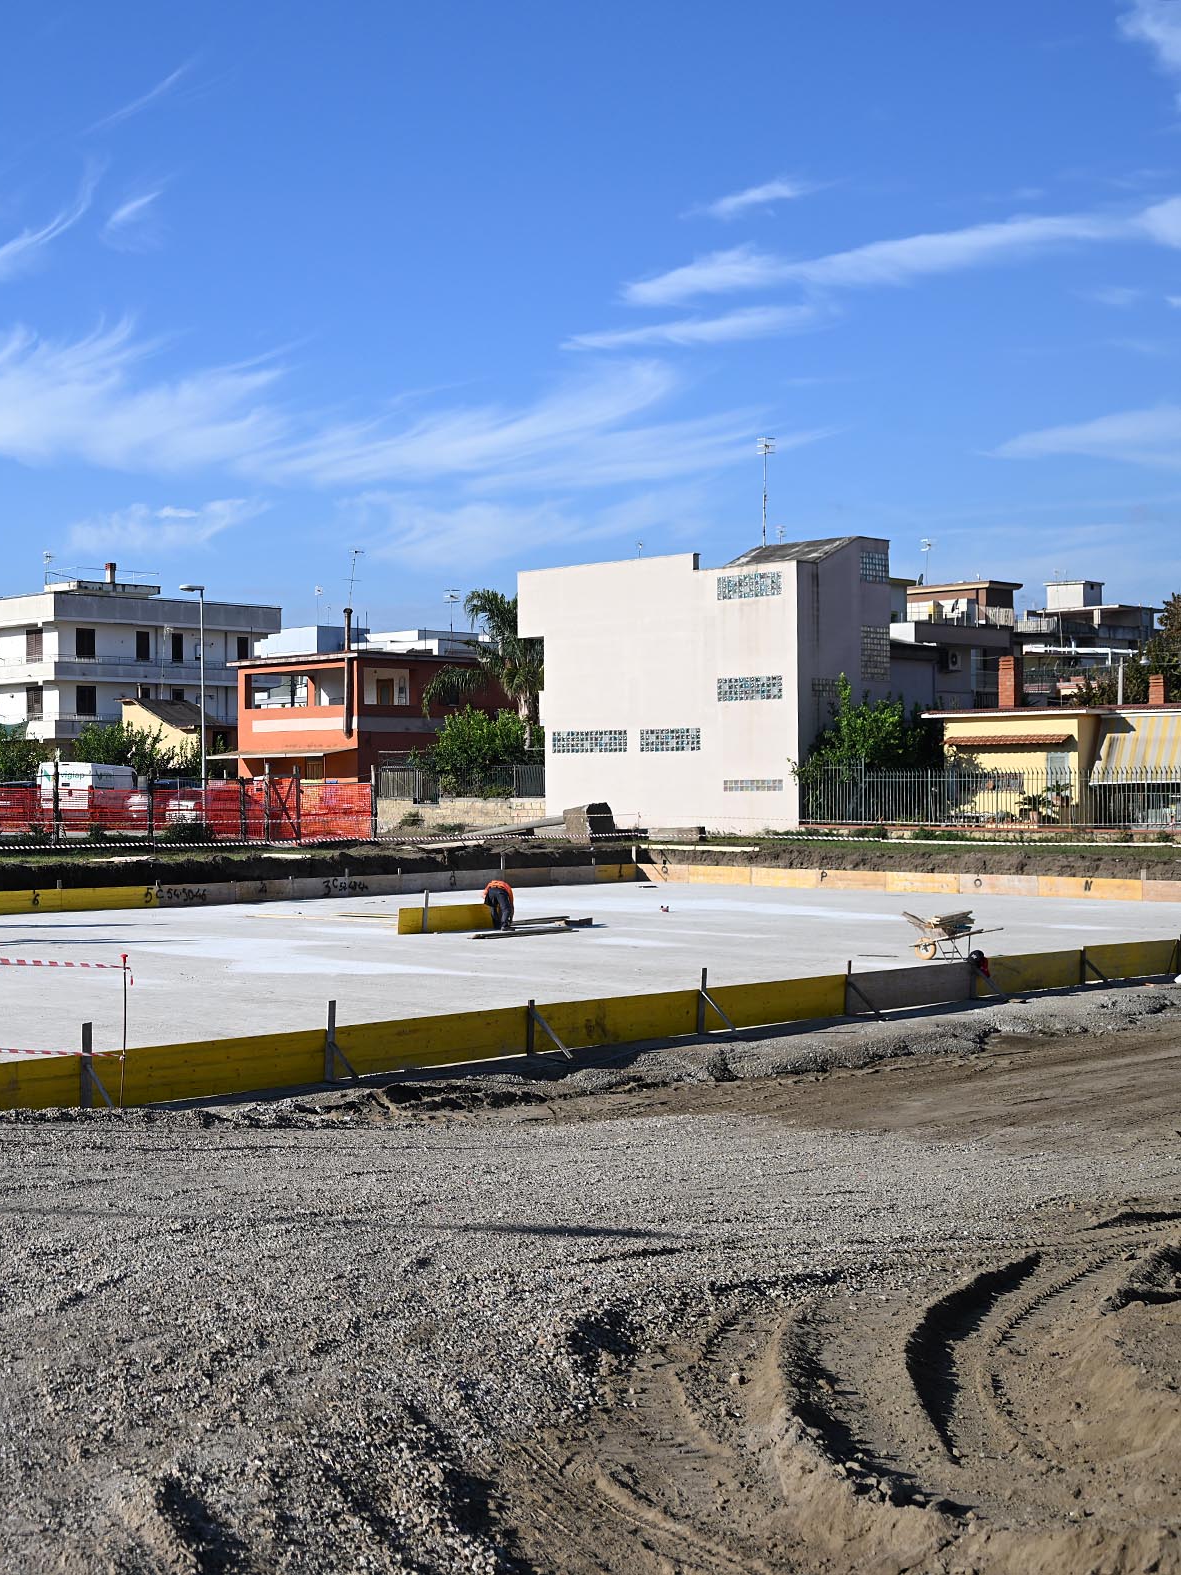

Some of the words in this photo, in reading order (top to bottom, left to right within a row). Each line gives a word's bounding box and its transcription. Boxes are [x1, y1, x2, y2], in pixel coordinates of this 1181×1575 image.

[820, 870, 828, 882] P
[323, 880, 332, 896] 3
[1084, 879, 1093, 892] N
[144, 887, 154, 903] 5
